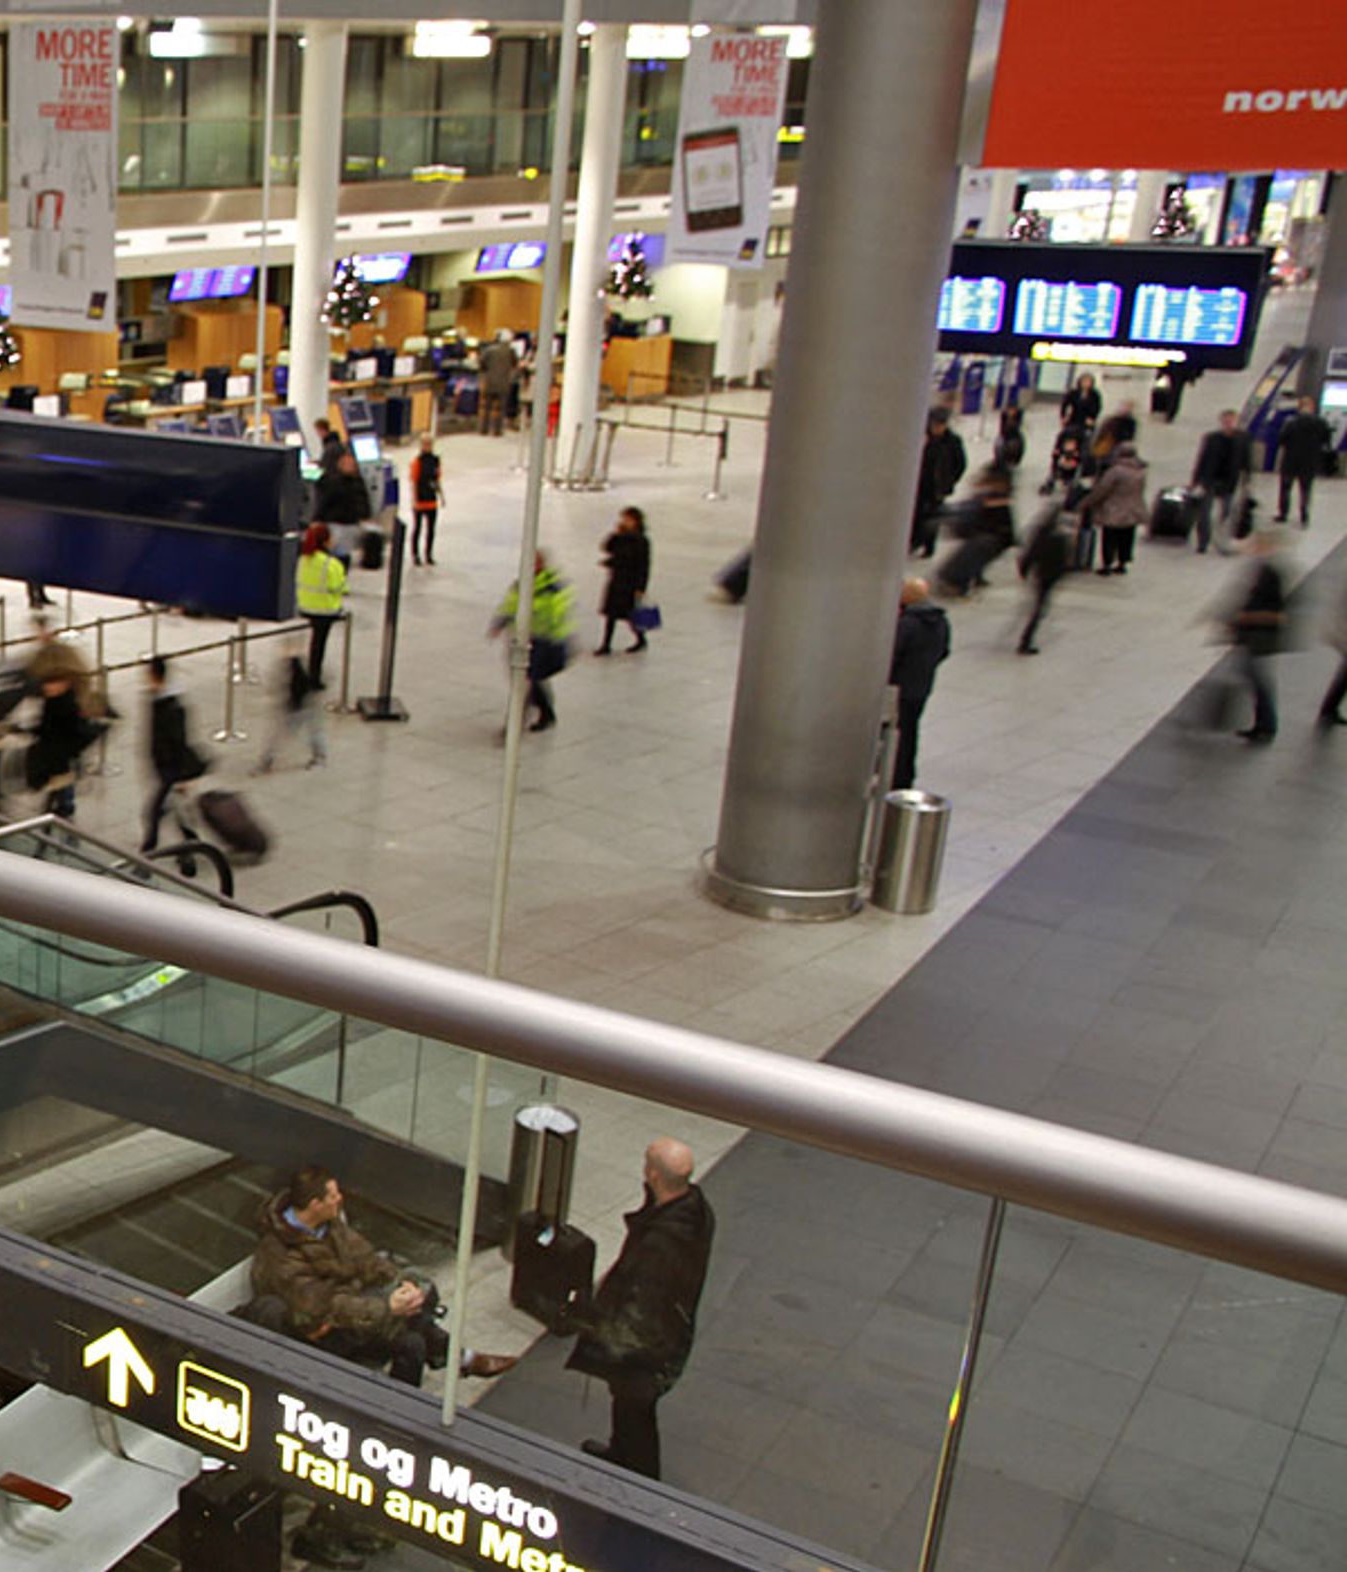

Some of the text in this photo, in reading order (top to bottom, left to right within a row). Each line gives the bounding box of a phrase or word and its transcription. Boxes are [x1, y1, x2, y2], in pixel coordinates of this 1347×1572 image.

[36, 28, 113, 61] MORE
[711, 39, 782, 62] MORE
[59, 63, 112, 89] TIME
[733, 62, 778, 84] TIME
[278, 1392, 558, 1541] Tog og Metro
[275, 1433, 374, 1507] Train
[384, 1488, 466, 1546] and
